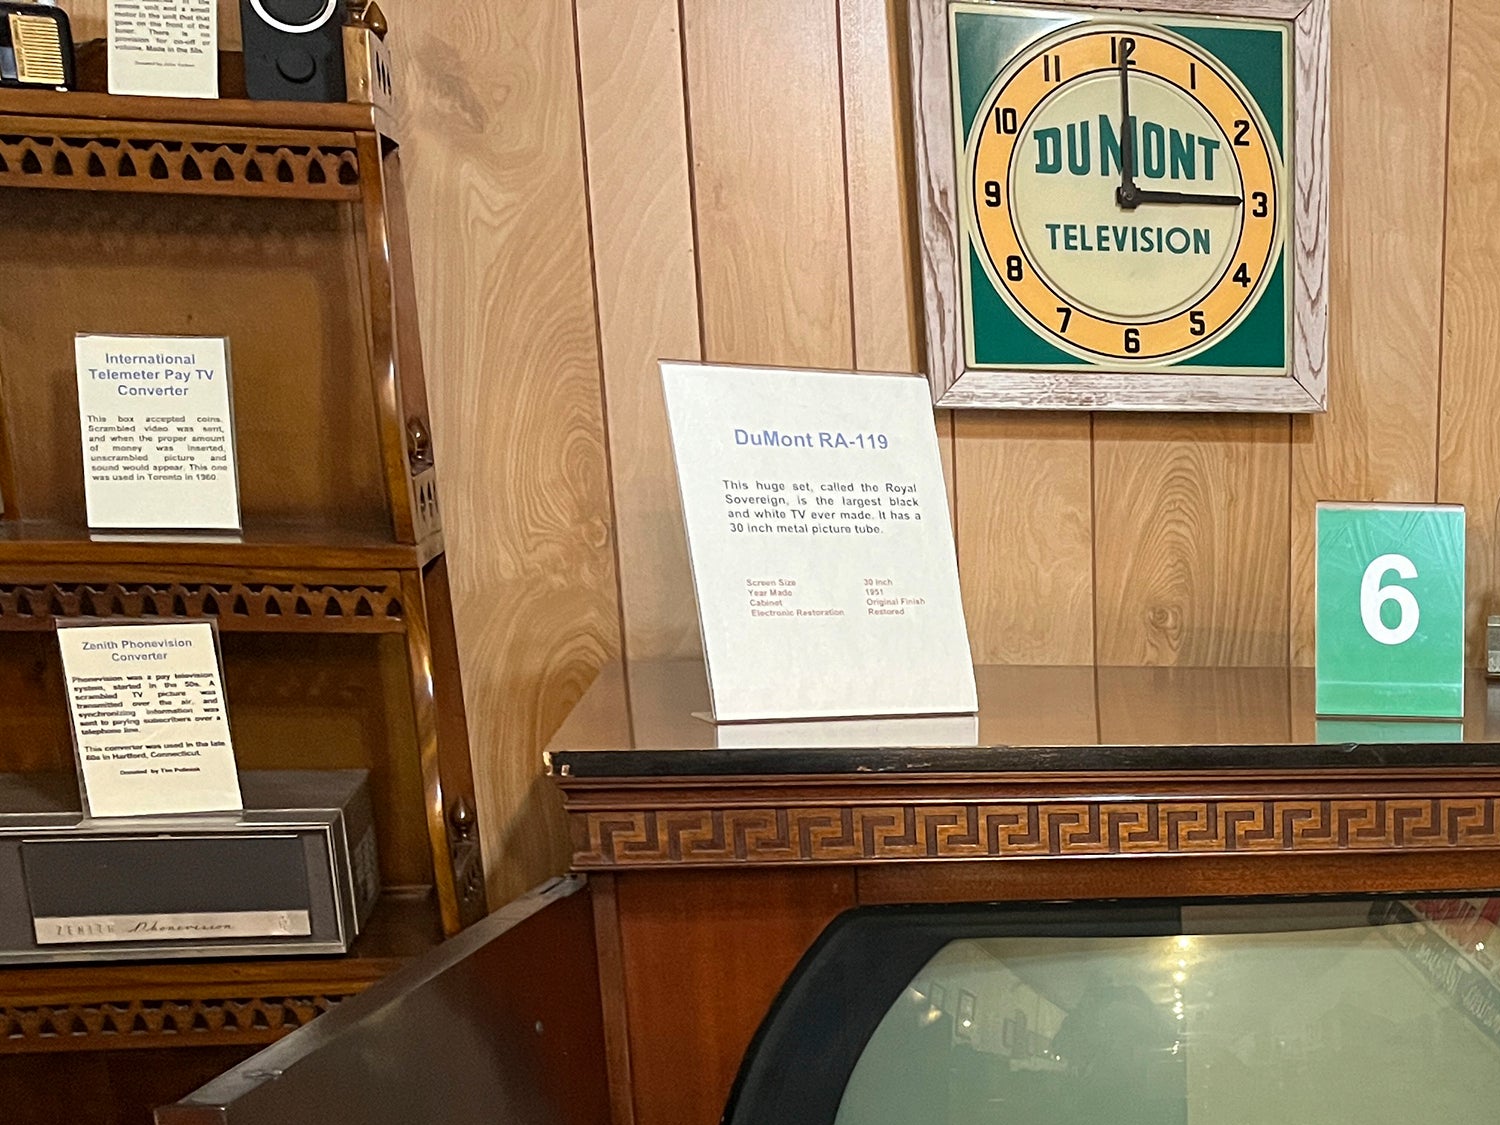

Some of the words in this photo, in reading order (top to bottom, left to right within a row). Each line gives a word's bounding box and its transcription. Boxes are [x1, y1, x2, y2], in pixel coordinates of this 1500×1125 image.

[1044, 54, 1061, 83] 11
[1190, 63, 1196, 90] 1
[995, 108, 1017, 135] 10
[1233, 120, 1250, 146] 2
[985, 181, 1001, 207] 9
[1252, 192, 1268, 218] 3
[1045, 224, 1210, 254] TELEVISION
[1006, 256, 1023, 282] 8
[1233, 263, 1251, 287] 4
[1056, 308, 1072, 333] 7
[1190, 311, 1205, 336] 5
[1124, 328, 1140, 354] 6
[106, 353, 195, 364] International
[88, 369, 160, 380] Telemeter
[165, 369, 191, 383] Pay
[195, 369, 214, 380] TV
[118, 385, 189, 396] Converter
[146, 416, 186, 424] accepted
[734, 429, 814, 448] DuMont
[819, 432, 888, 449] RA-119
[722, 480, 748, 490] This
[756, 480, 784, 492] huge
[793, 483, 813, 492] set,
[820, 482, 854, 492] called
[861, 483, 878, 492] the
[885, 483, 916, 495] Royal
[725, 494, 789, 507] Sovereign,
[798, 496, 807, 505] is
[816, 496, 834, 505] the
[842, 496, 881, 508] largest
[889, 497, 919, 506] black
[728, 509, 750, 518] and
[754, 509, 786, 519] white
[790, 509, 805, 519] TV
[840, 511, 874, 520] made.
[878, 510, 886, 520] It
[890, 510, 910, 520] has
[730, 523, 744, 532] 30
[748, 523, 773, 533] inch
[777, 524, 808, 533] metal
[812, 524, 851, 535] picture
[854, 524, 883, 534] tube.
[866, 598, 898, 607] Original
[868, 606, 904, 615] Restored
[1360, 554, 1420, 646] 6
[82, 641, 118, 650] Zenith
[121, 639, 192, 649] Phonevision
[112, 652, 167, 662] Converter
